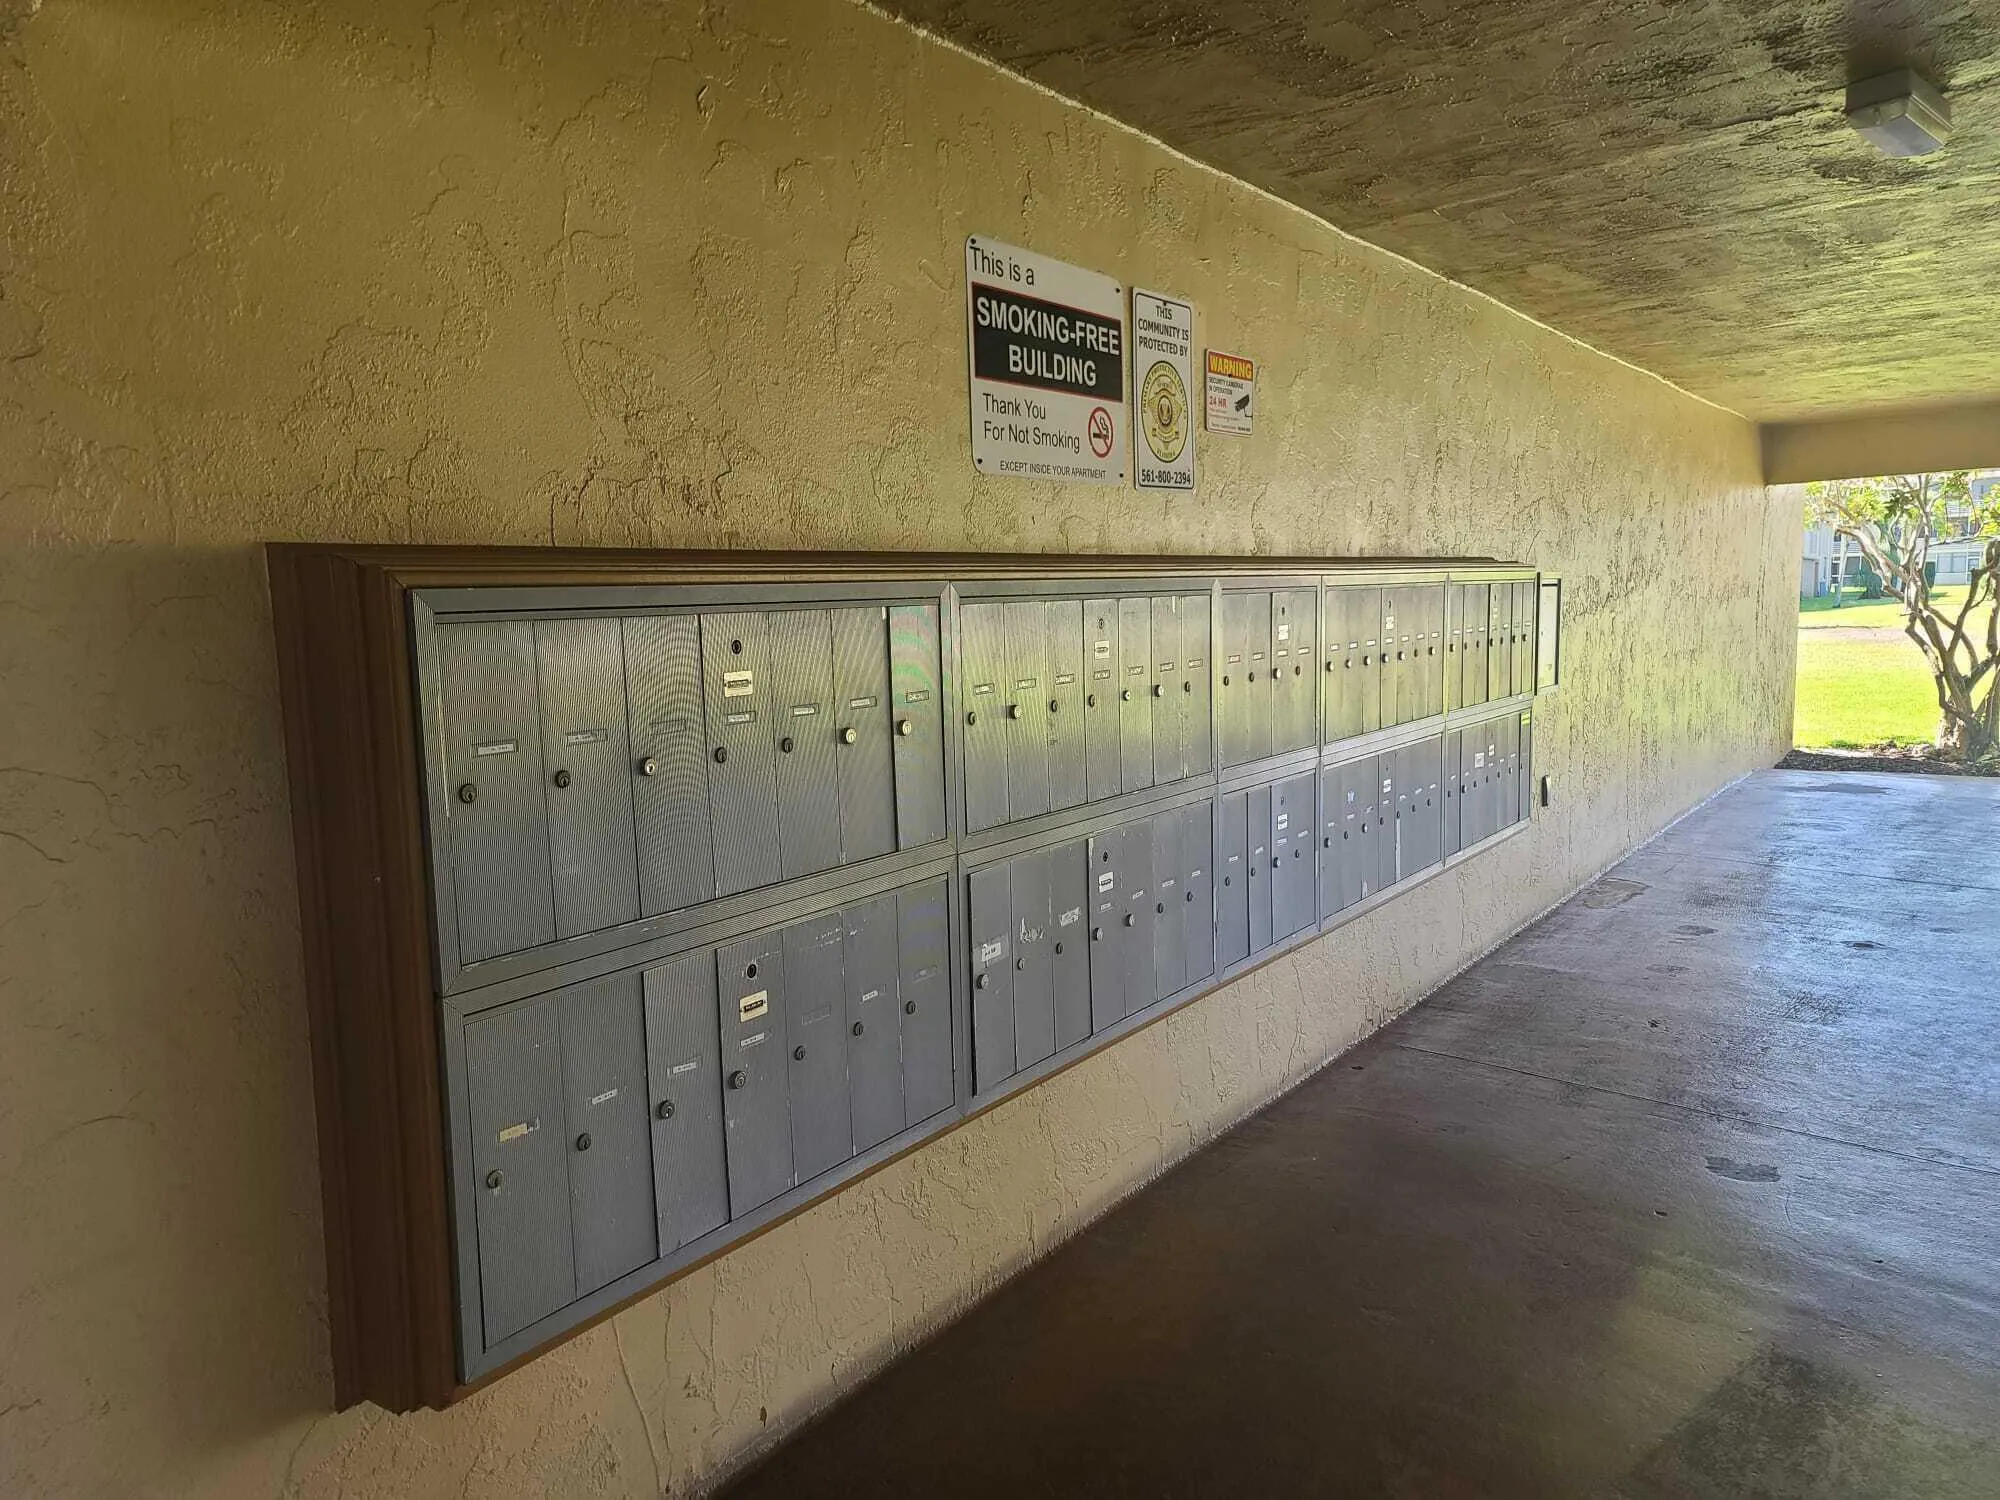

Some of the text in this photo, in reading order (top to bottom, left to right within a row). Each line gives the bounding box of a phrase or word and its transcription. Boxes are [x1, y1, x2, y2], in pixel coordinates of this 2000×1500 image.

[970, 246, 1035, 286] This is a
[977, 296, 1120, 355] SMOKING-FREE
[1155, 305, 1173, 320] THIS
[1138, 318, 1189, 341] COMMUNITY IS
[1138, 335, 1188, 357] PROTECTED BY
[1009, 344, 1097, 387] BUILDING
[1209, 354, 1252, 379] WARNING
[982, 393, 1046, 420] Thank You
[984, 421, 1080, 454] For Not Smoking
[1000, 460, 1107, 480] EXCEPT INSIDE YOUR APARTMENT
